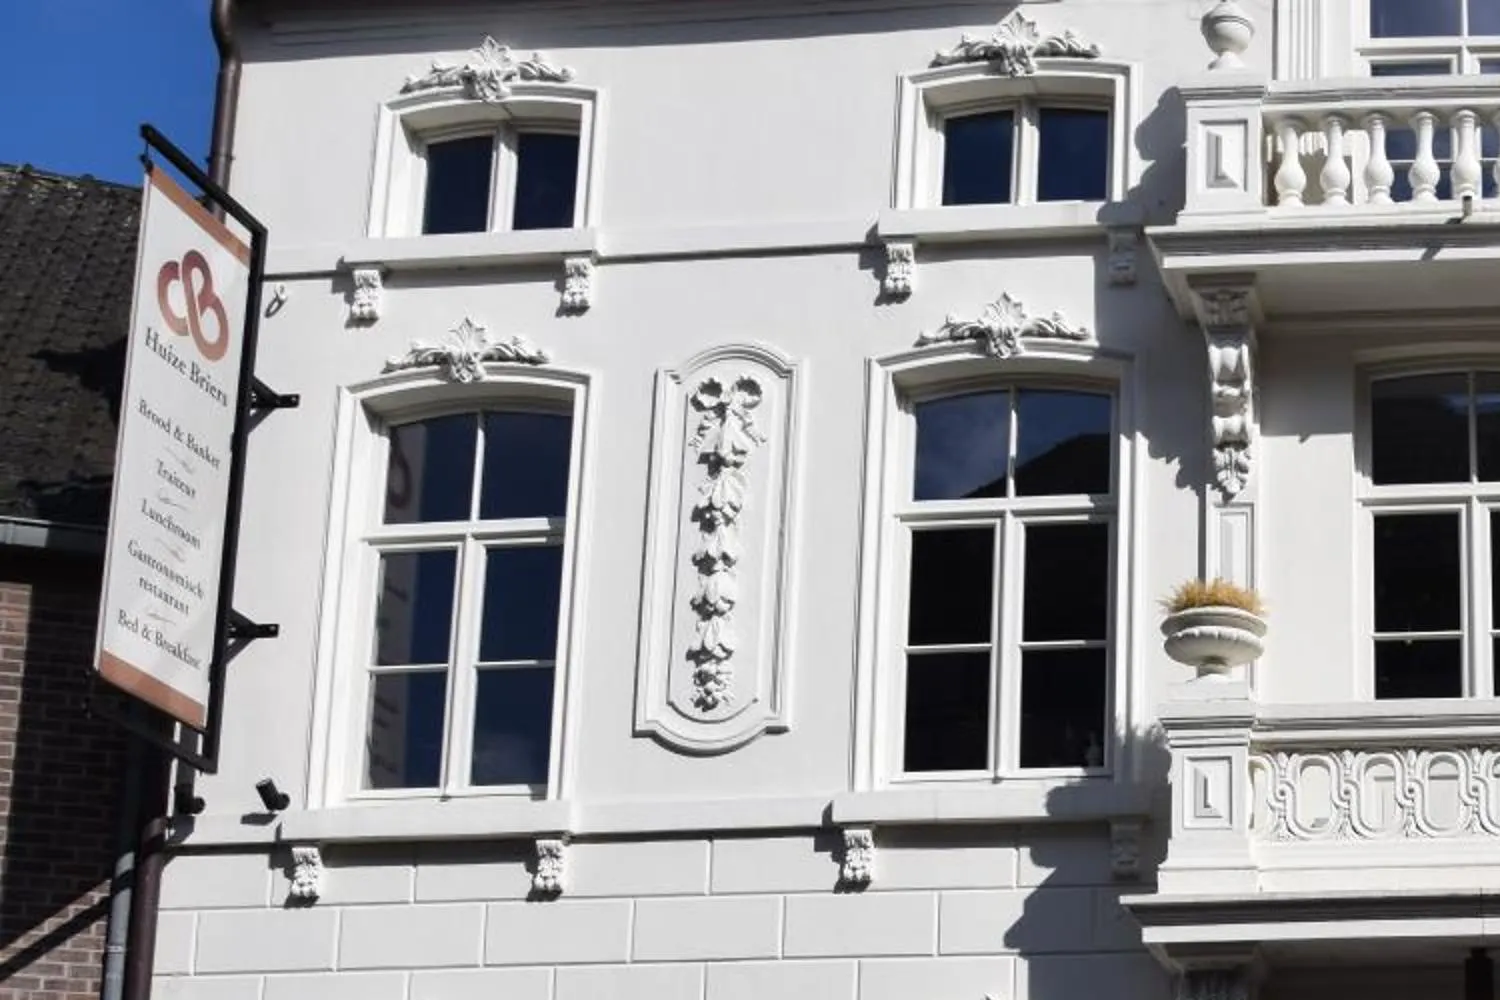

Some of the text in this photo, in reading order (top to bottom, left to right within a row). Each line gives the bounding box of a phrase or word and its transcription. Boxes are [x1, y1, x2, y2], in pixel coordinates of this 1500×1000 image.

[144, 326, 187, 376] Huize
[138, 398, 220, 470] Brood & Banket
[117, 608, 138, 633] Bed
[141, 624, 152, 642] &
